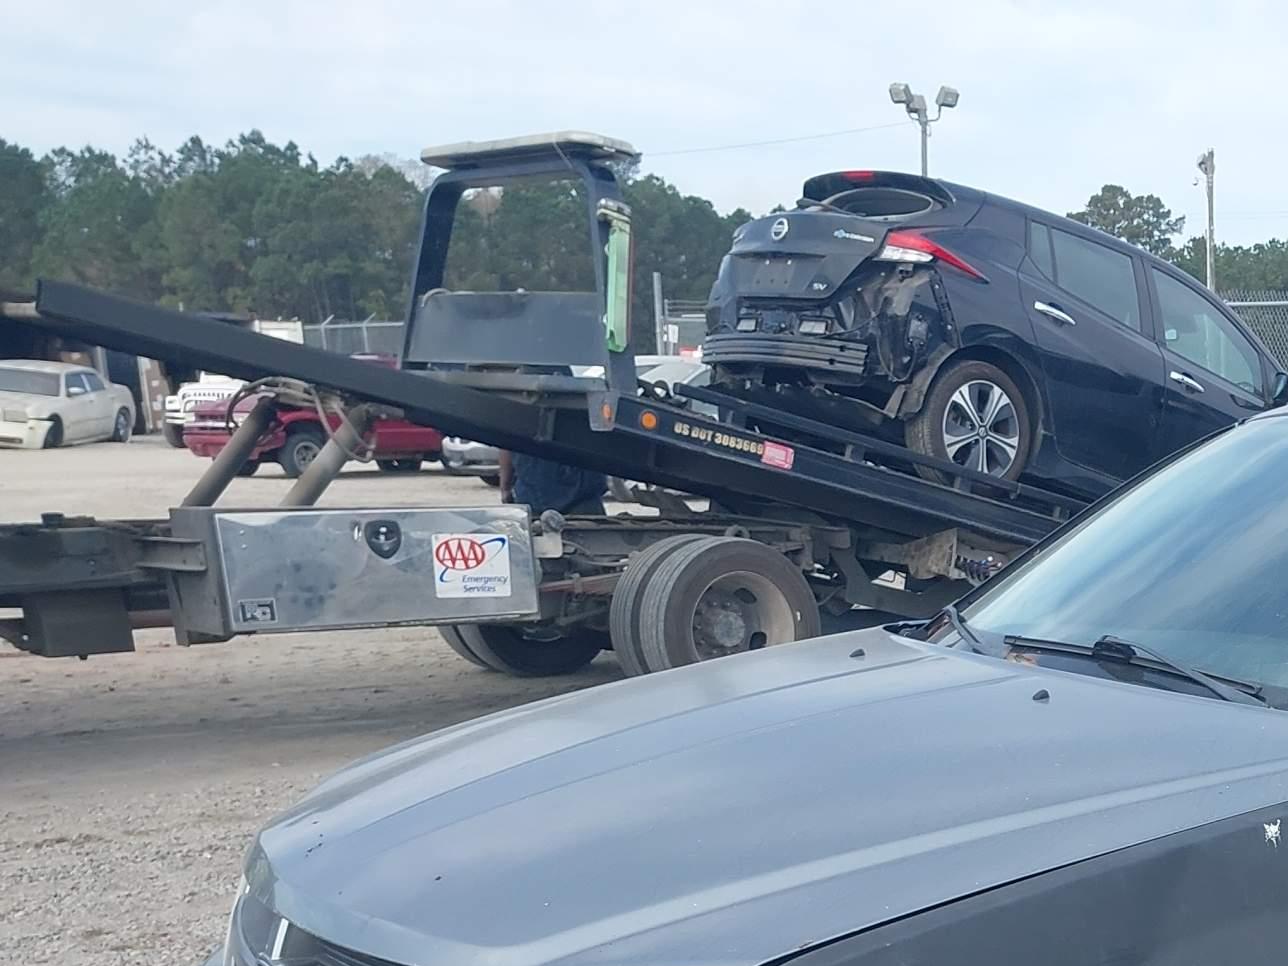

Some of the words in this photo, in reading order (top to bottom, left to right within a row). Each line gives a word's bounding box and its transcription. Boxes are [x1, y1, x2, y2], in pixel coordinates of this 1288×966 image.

[812, 282, 828, 291] SV
[674, 422, 690, 436] US
[690, 427, 714, 442] DOT
[438, 538, 483, 570] AAA
[462, 574, 509, 585] Emergency
[463, 584, 497, 593] Services
